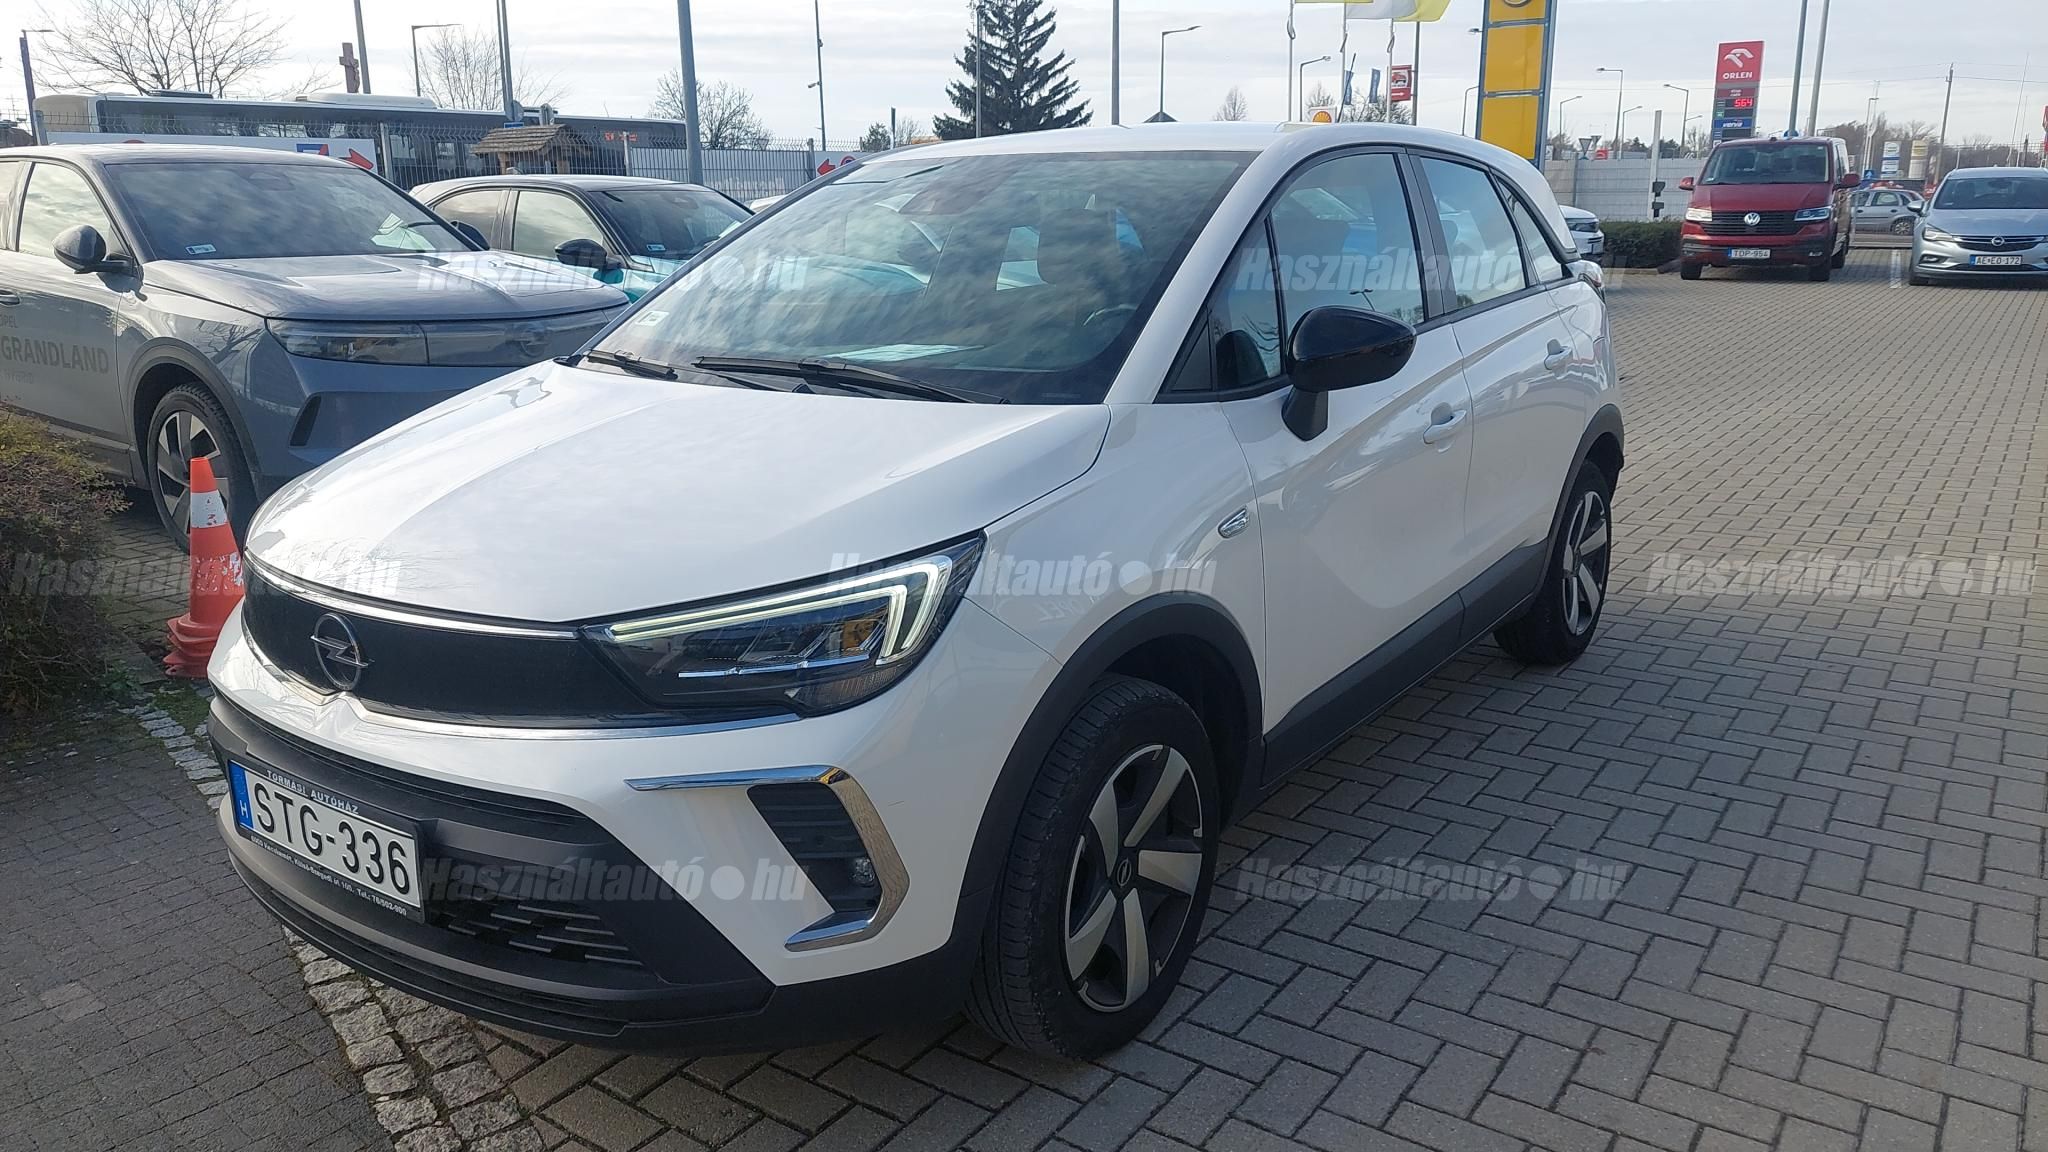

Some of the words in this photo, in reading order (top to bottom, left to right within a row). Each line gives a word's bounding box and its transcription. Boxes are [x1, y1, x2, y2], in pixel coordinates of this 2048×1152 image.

[1723, 71, 1753, 80] ORLEN
[1734, 98, 1753, 108] 564
[1, 335, 109, 374] GRANDLAND
[239, 800, 249, 819] H
[310, 789, 359, 815] AUTÓHÁZ
[254, 782, 410, 895] STG-336
